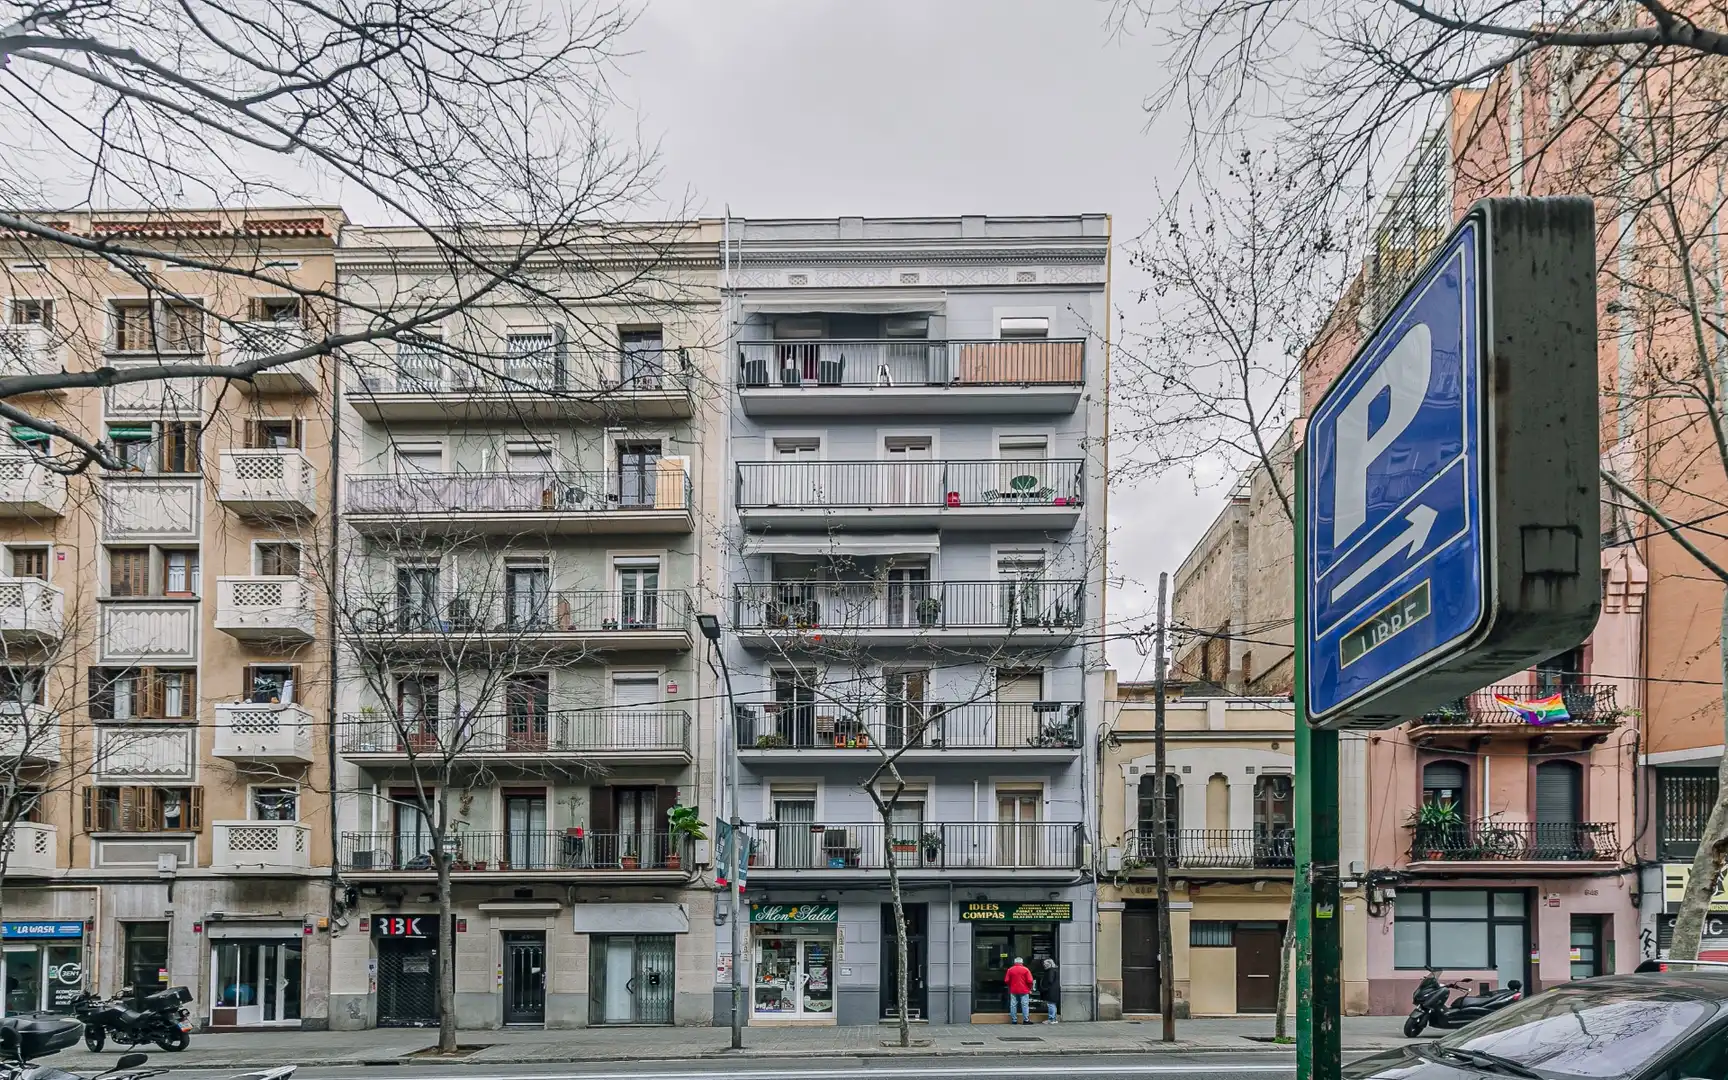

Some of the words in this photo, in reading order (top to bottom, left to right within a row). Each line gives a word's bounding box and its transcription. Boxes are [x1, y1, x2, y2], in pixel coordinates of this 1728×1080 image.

[1333, 323, 1432, 549] P
[755, 905, 790, 921] Mon
[793, 905, 837, 921] Salut
[969, 903, 999, 911] IDEES
[379, 917, 422, 935] RBK
